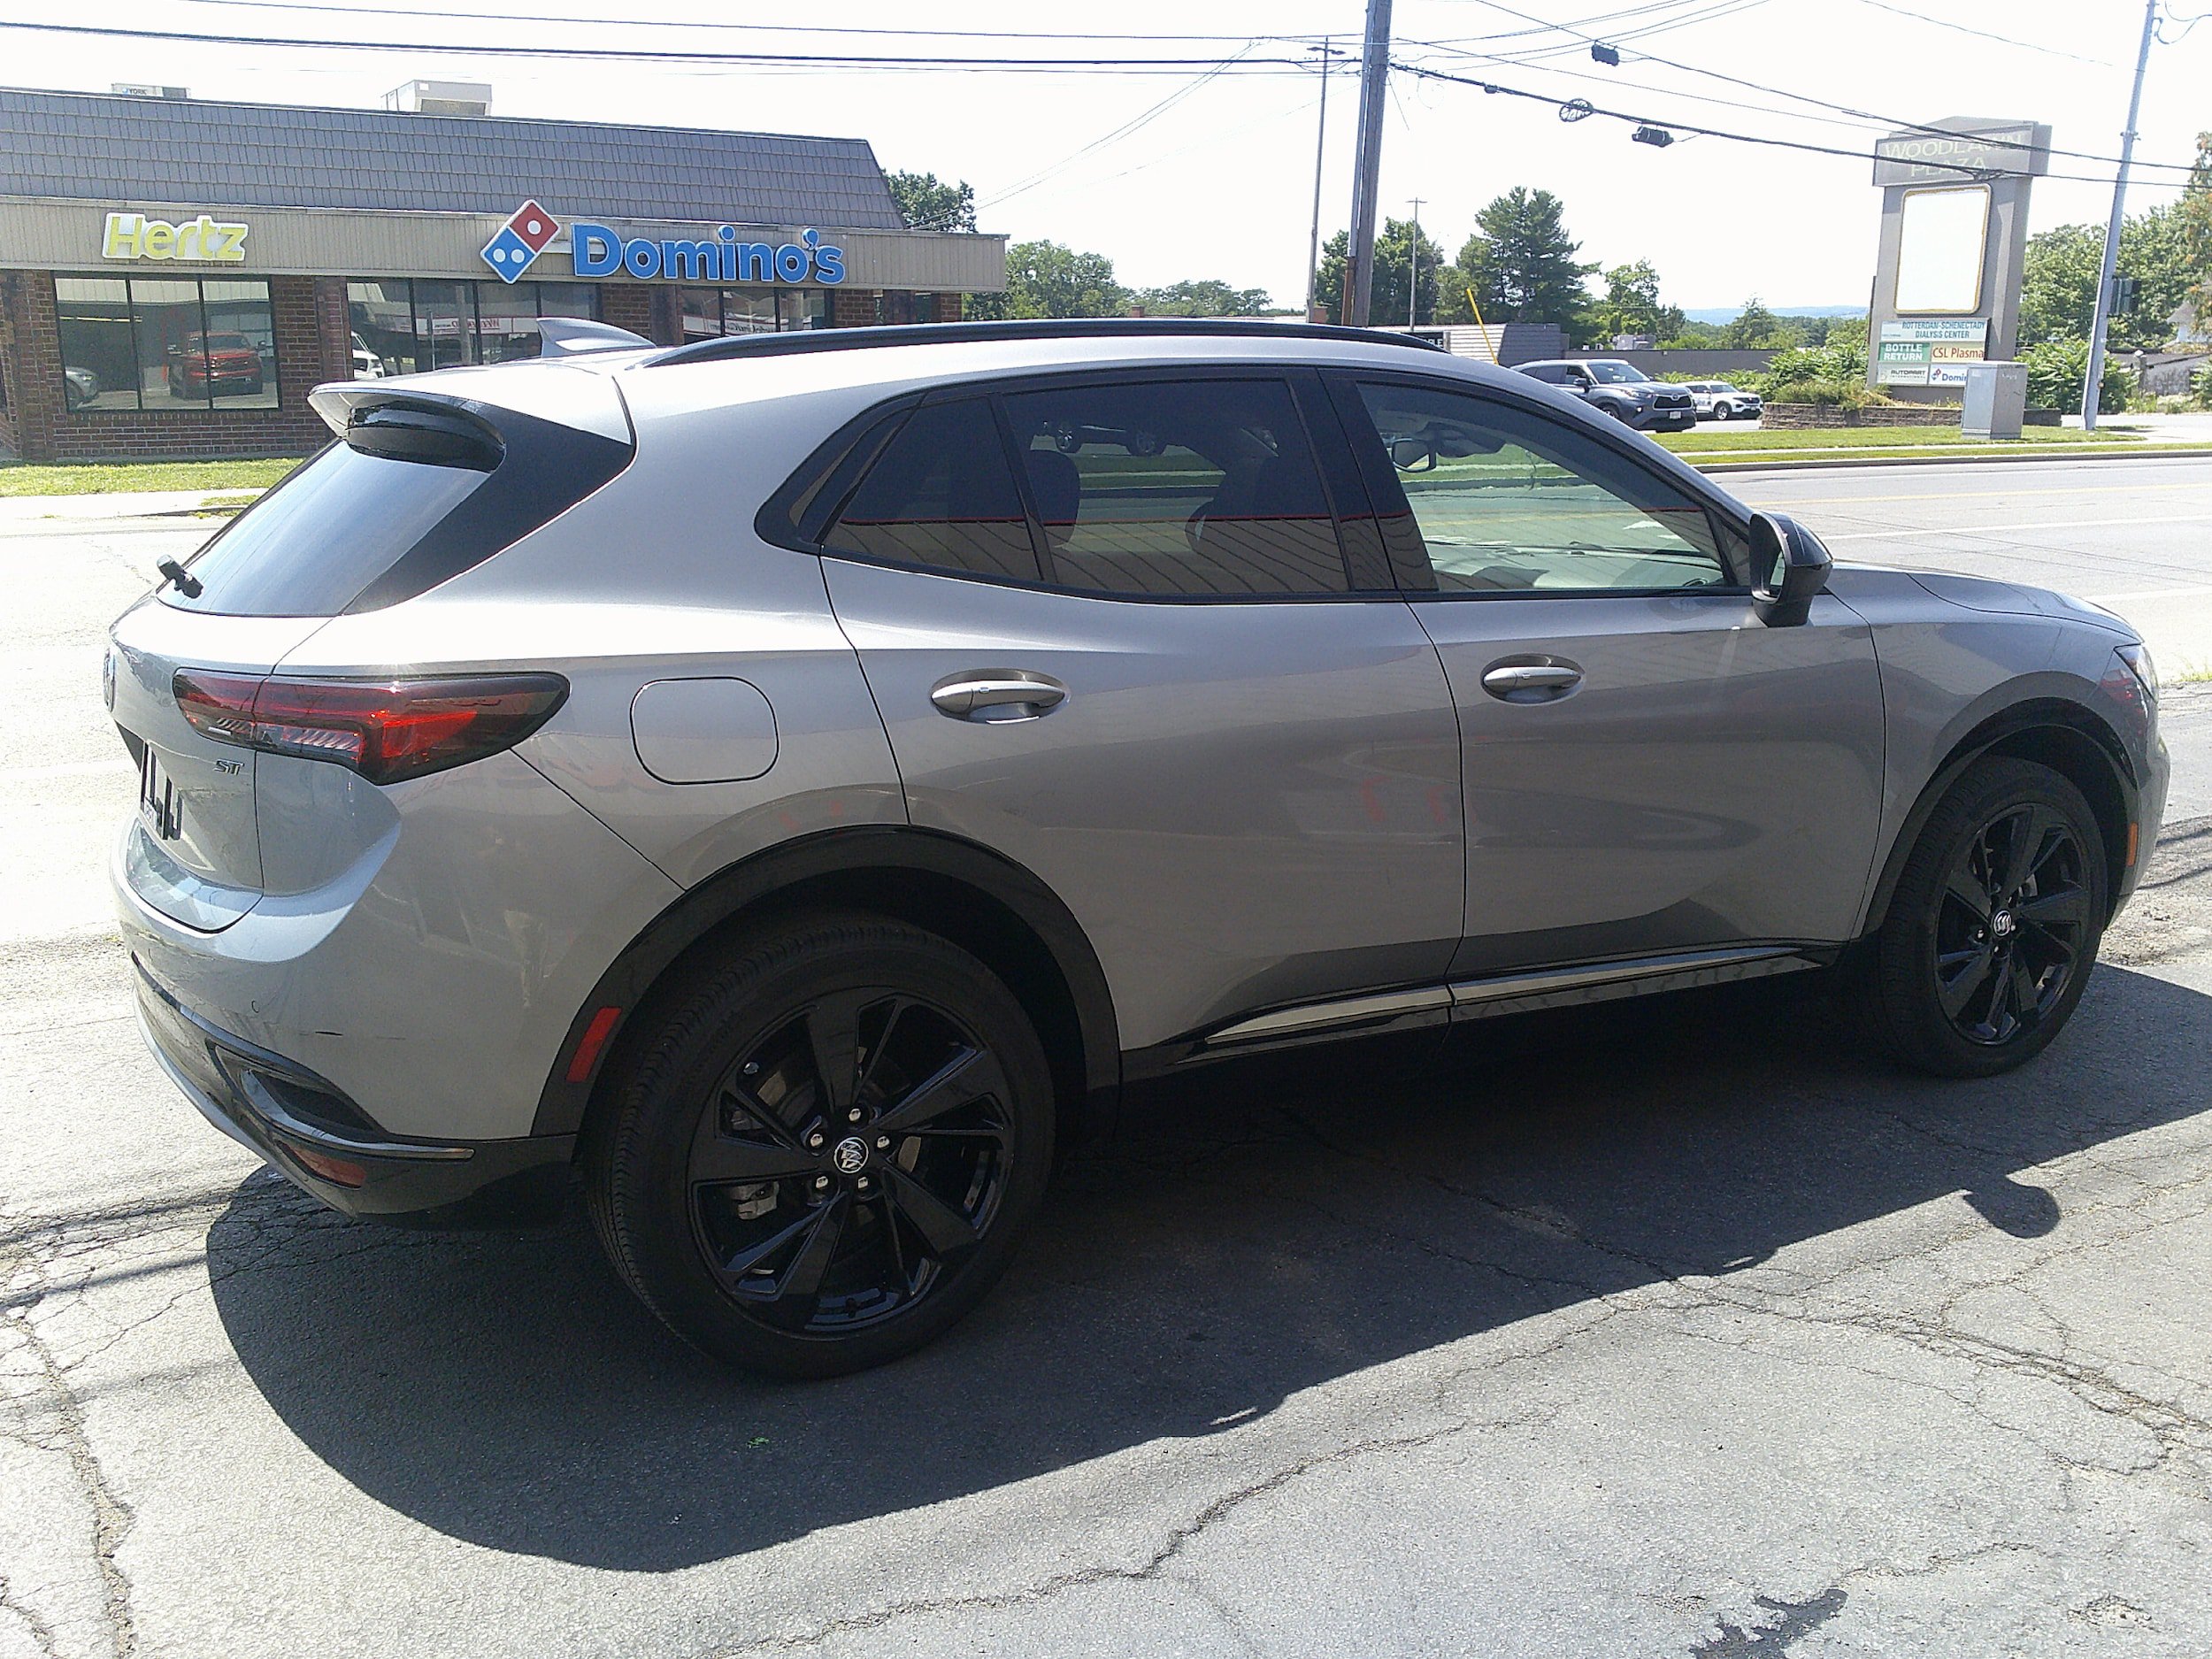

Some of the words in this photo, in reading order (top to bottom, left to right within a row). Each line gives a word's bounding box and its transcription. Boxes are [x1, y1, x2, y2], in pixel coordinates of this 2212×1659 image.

[1910, 157, 1986, 177] PLAZA
[104, 214, 247, 260] Hertz
[571, 221, 846, 284] Domino's
[1915, 330, 1943, 339] DIALYSIS
[1885, 343, 1923, 352] BOTTLE
[1932, 347, 1948, 358] CSL
[1950, 347, 1985, 358] Plasma
[1883, 352, 1923, 361] RETURN
[212, 758, 244, 776] ST
